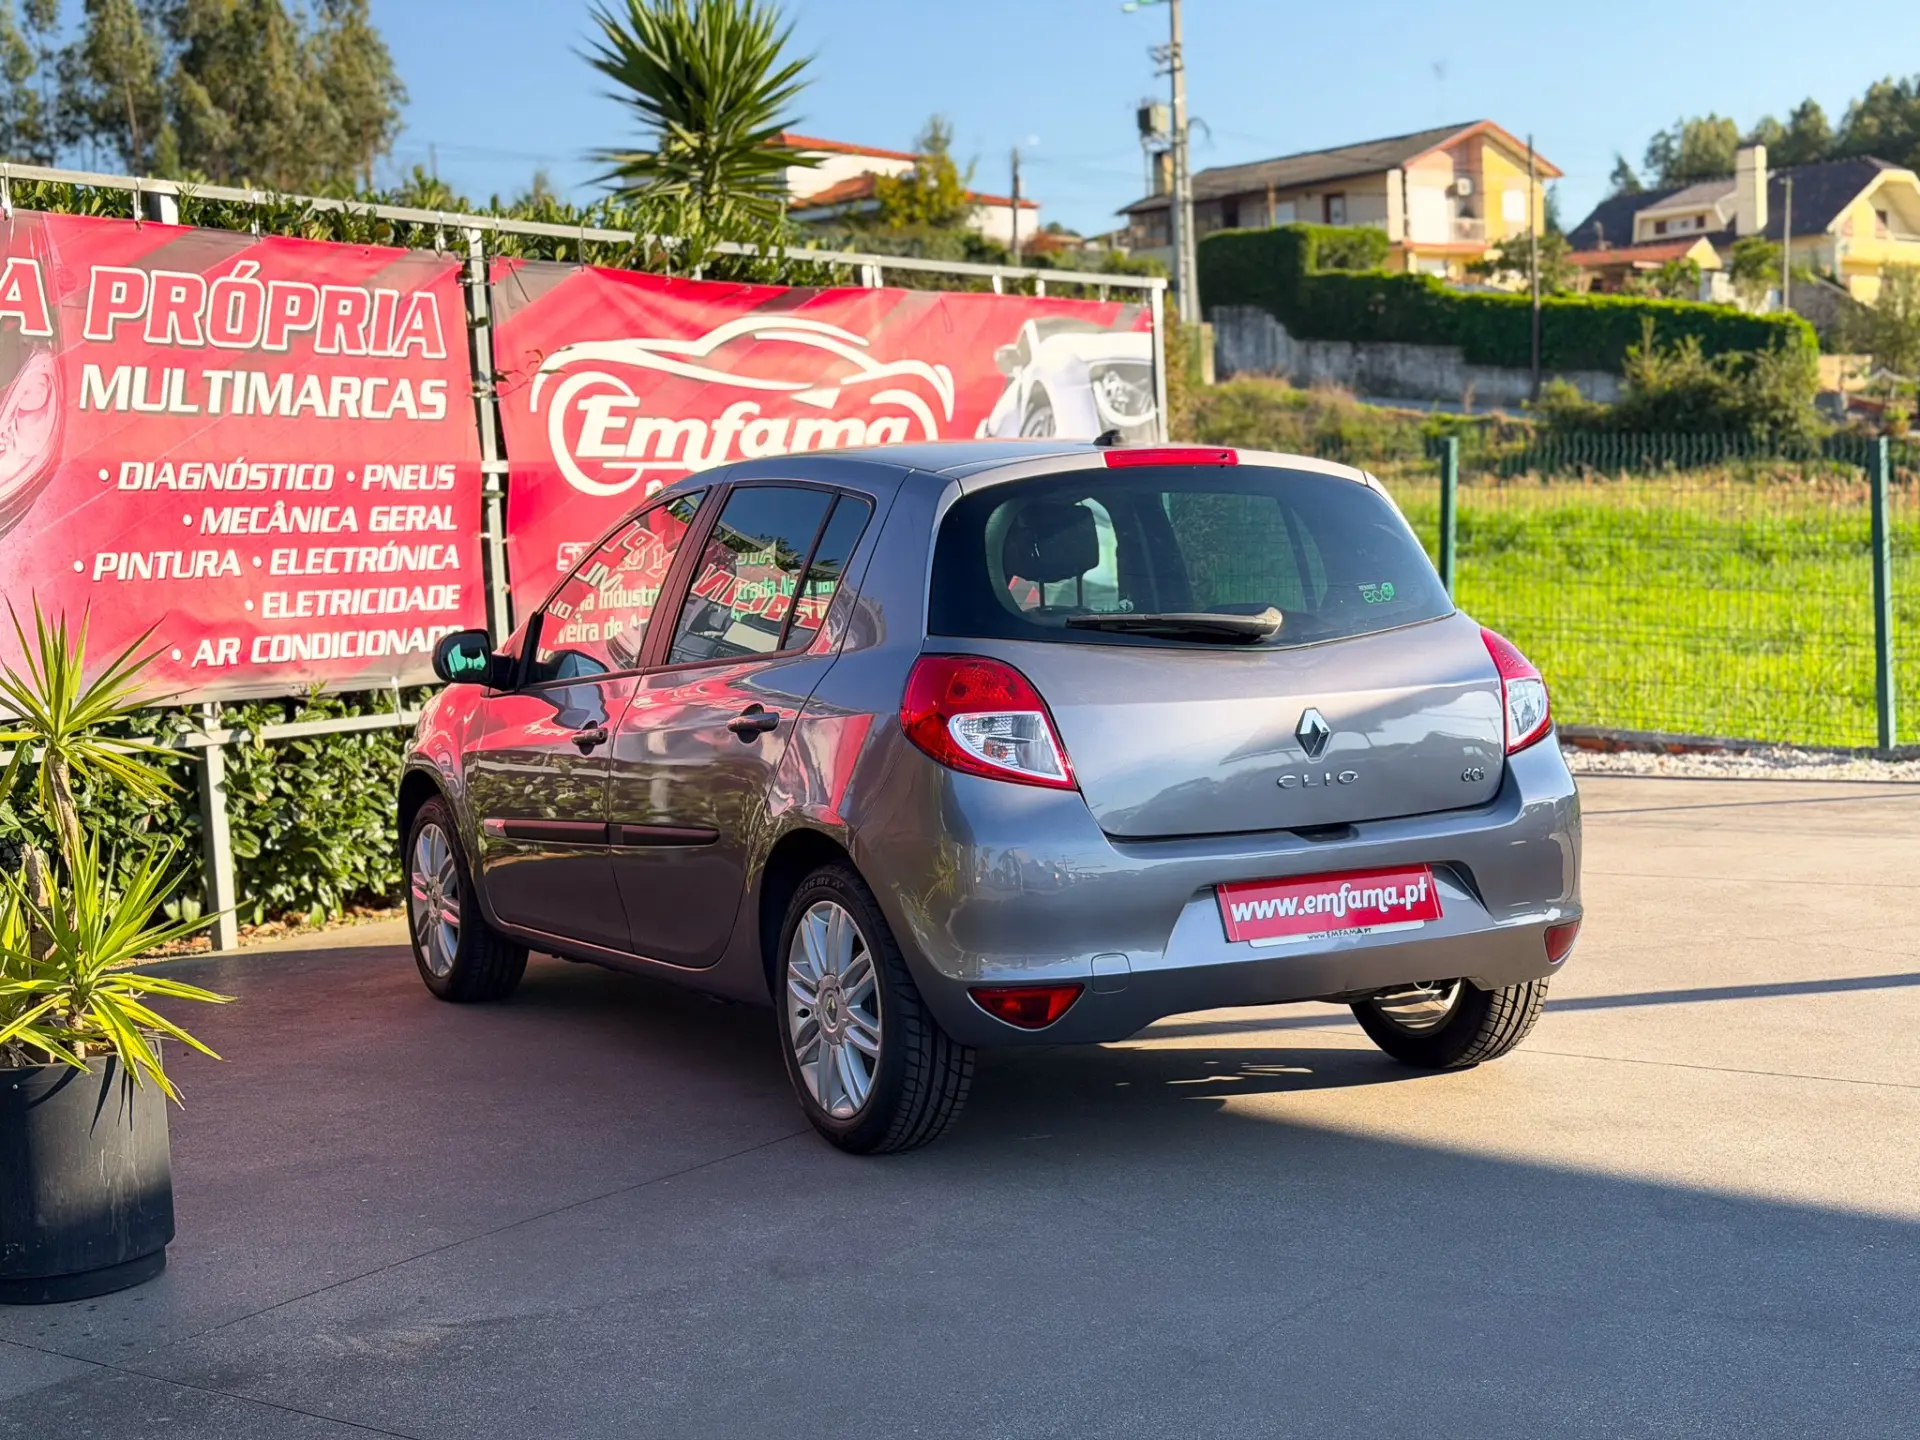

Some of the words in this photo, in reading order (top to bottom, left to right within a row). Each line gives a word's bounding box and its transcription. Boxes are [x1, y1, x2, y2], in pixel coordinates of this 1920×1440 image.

[83, 260, 447, 358] PRÓPRIA
[79, 364, 447, 420] MULTIMARCAS
[574, 395, 911, 469] Emfama
[118, 457, 334, 490] DIAGNÓSTICO
[362, 464, 456, 490] PNEUS
[200, 500, 358, 534] MECÂNICA
[369, 505, 457, 532] GERAL
[92, 549, 241, 581] PINTURA
[269, 540, 460, 576] ELECTRÓNICA
[262, 584, 461, 618] ELETRICIDADE
[191, 636, 240, 668] AR
[250, 625, 464, 663] CONDICIONAD
[1277, 771, 1358, 788] CLIO
[1230, 876, 1427, 922] www.emfama.pt
